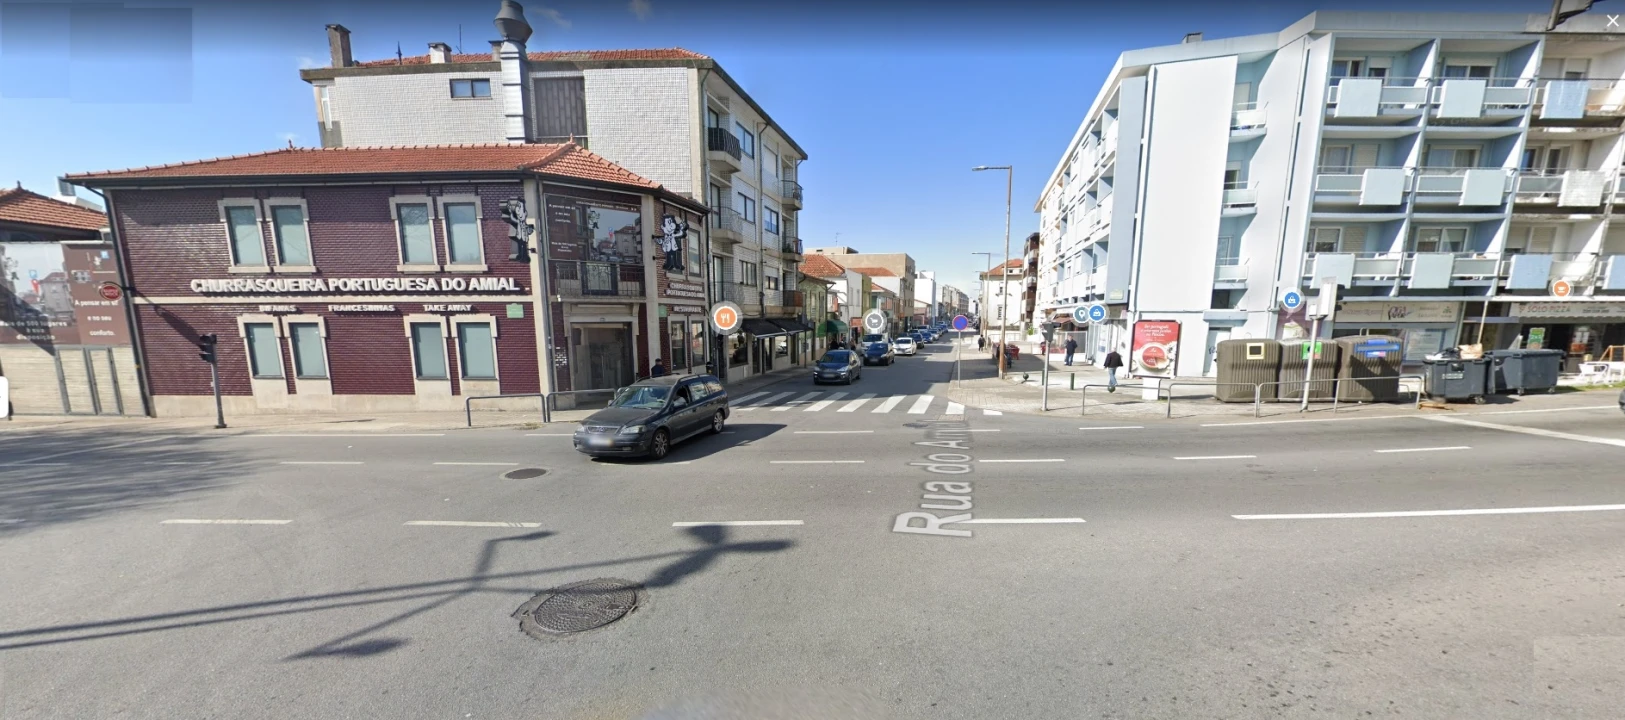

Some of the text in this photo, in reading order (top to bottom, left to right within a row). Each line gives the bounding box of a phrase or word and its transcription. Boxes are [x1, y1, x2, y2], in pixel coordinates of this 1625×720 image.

[190, 277, 520, 292] CHURRASQUEIRA PORTUGUESA DO AMIAL
